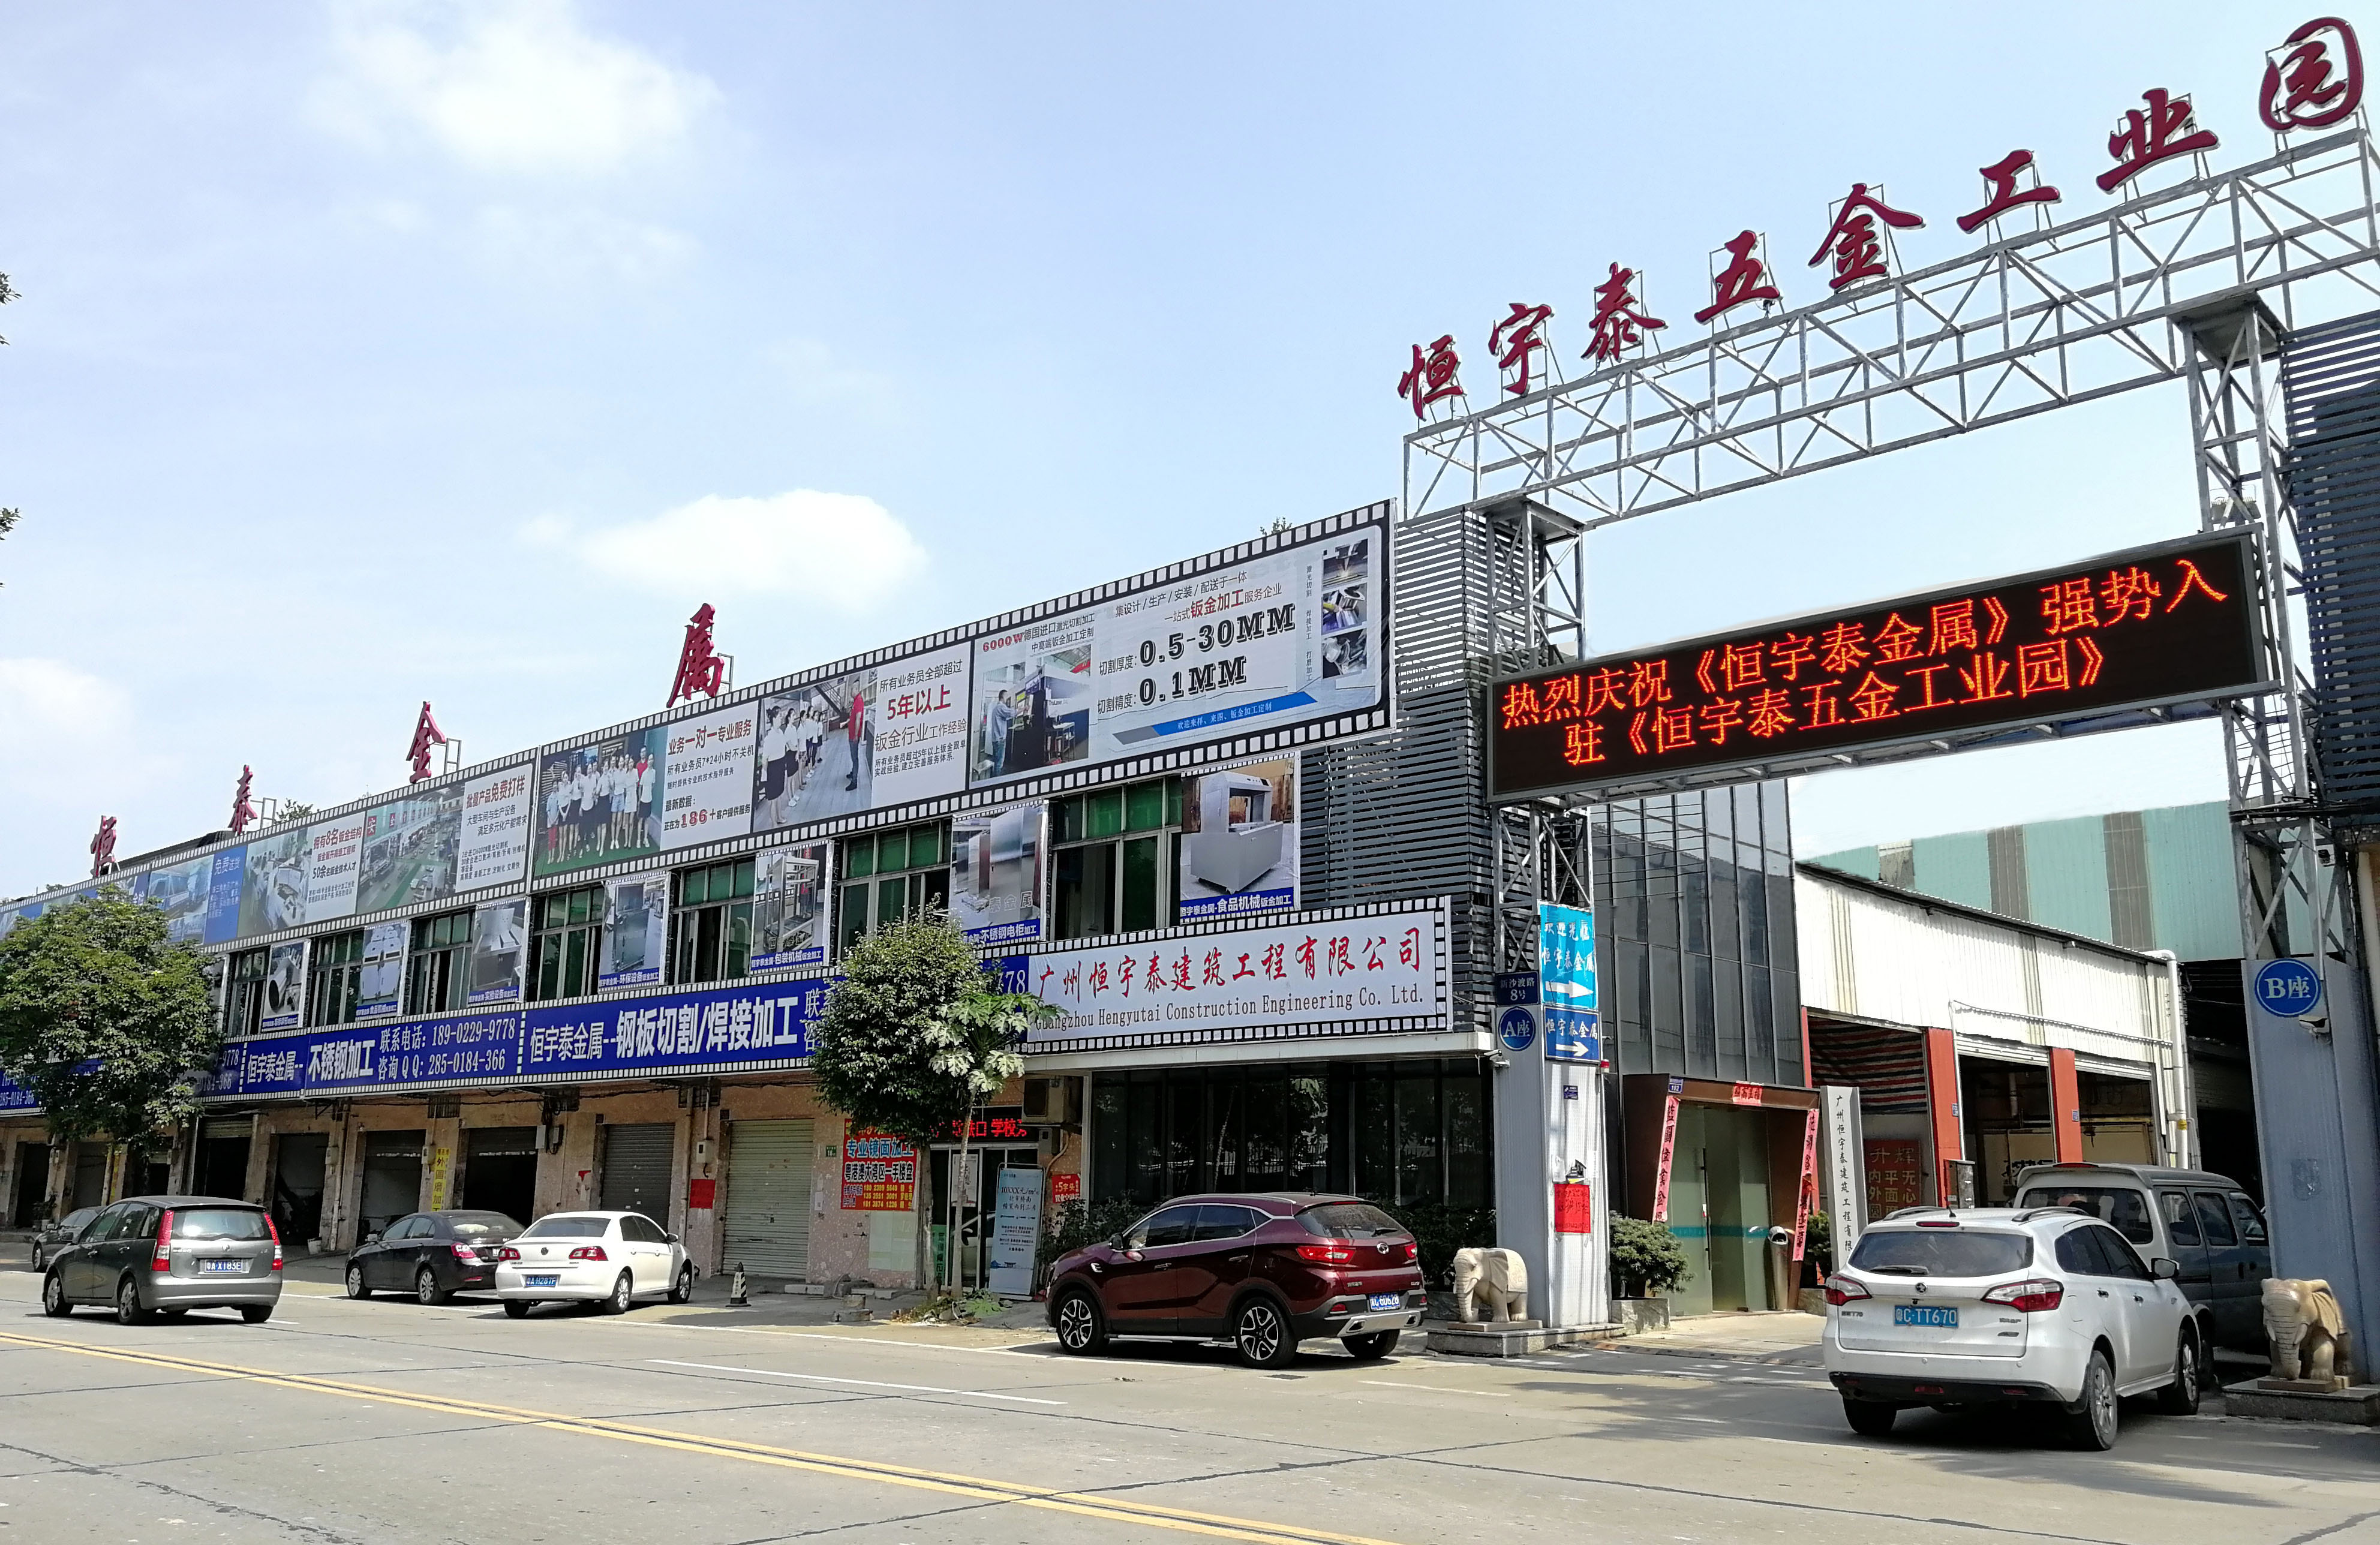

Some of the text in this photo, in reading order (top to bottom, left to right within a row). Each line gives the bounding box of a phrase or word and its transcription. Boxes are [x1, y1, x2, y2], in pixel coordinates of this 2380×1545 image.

[1398, 16, 2364, 419] 恒宇泰五金工业园
[1164, 582, 1282, 623] 一站式钣金加工服务企业
[1140, 603, 1296, 667] 0.5-30MM
[879, 659, 963, 693] 所有业务员全部超过
[1139, 656, 1248, 707] 0.1MM
[887, 684, 951, 720] 5年以上
[668, 719, 752, 756] 业务一对一专业服务
[875, 718, 967, 752] 钣金行业工作经验
[466, 774, 525, 809] 批量产品免费打样
[665, 795, 696, 812] 最新数据:
[467, 804, 516, 826] 大型车间与生产设备
[477, 814, 528, 837] 满足多元化产能需求
[1038, 927, 1422, 1003] 广州恒宇泰建筑工程有限公司
[1541, 946, 1595, 973] 恒宇泰金属
[2265, 976, 2311, 999] B座
[1098, 1005, 1161, 1027] Hengyutai
[1166, 997, 1257, 1021] Construction
[1262, 990, 1353, 1016] Engineering
[1358, 988, 1382, 1007] Co.
[1392, 983, 1424, 1005] Ltd.
[432, 1018, 515, 1046] 189-0229-9778
[1502, 1020, 1531, 1038] A座
[1546, 1018, 1598, 1040] 恒宇泰金属
[428, 1048, 506, 1075] 285-0184-366
